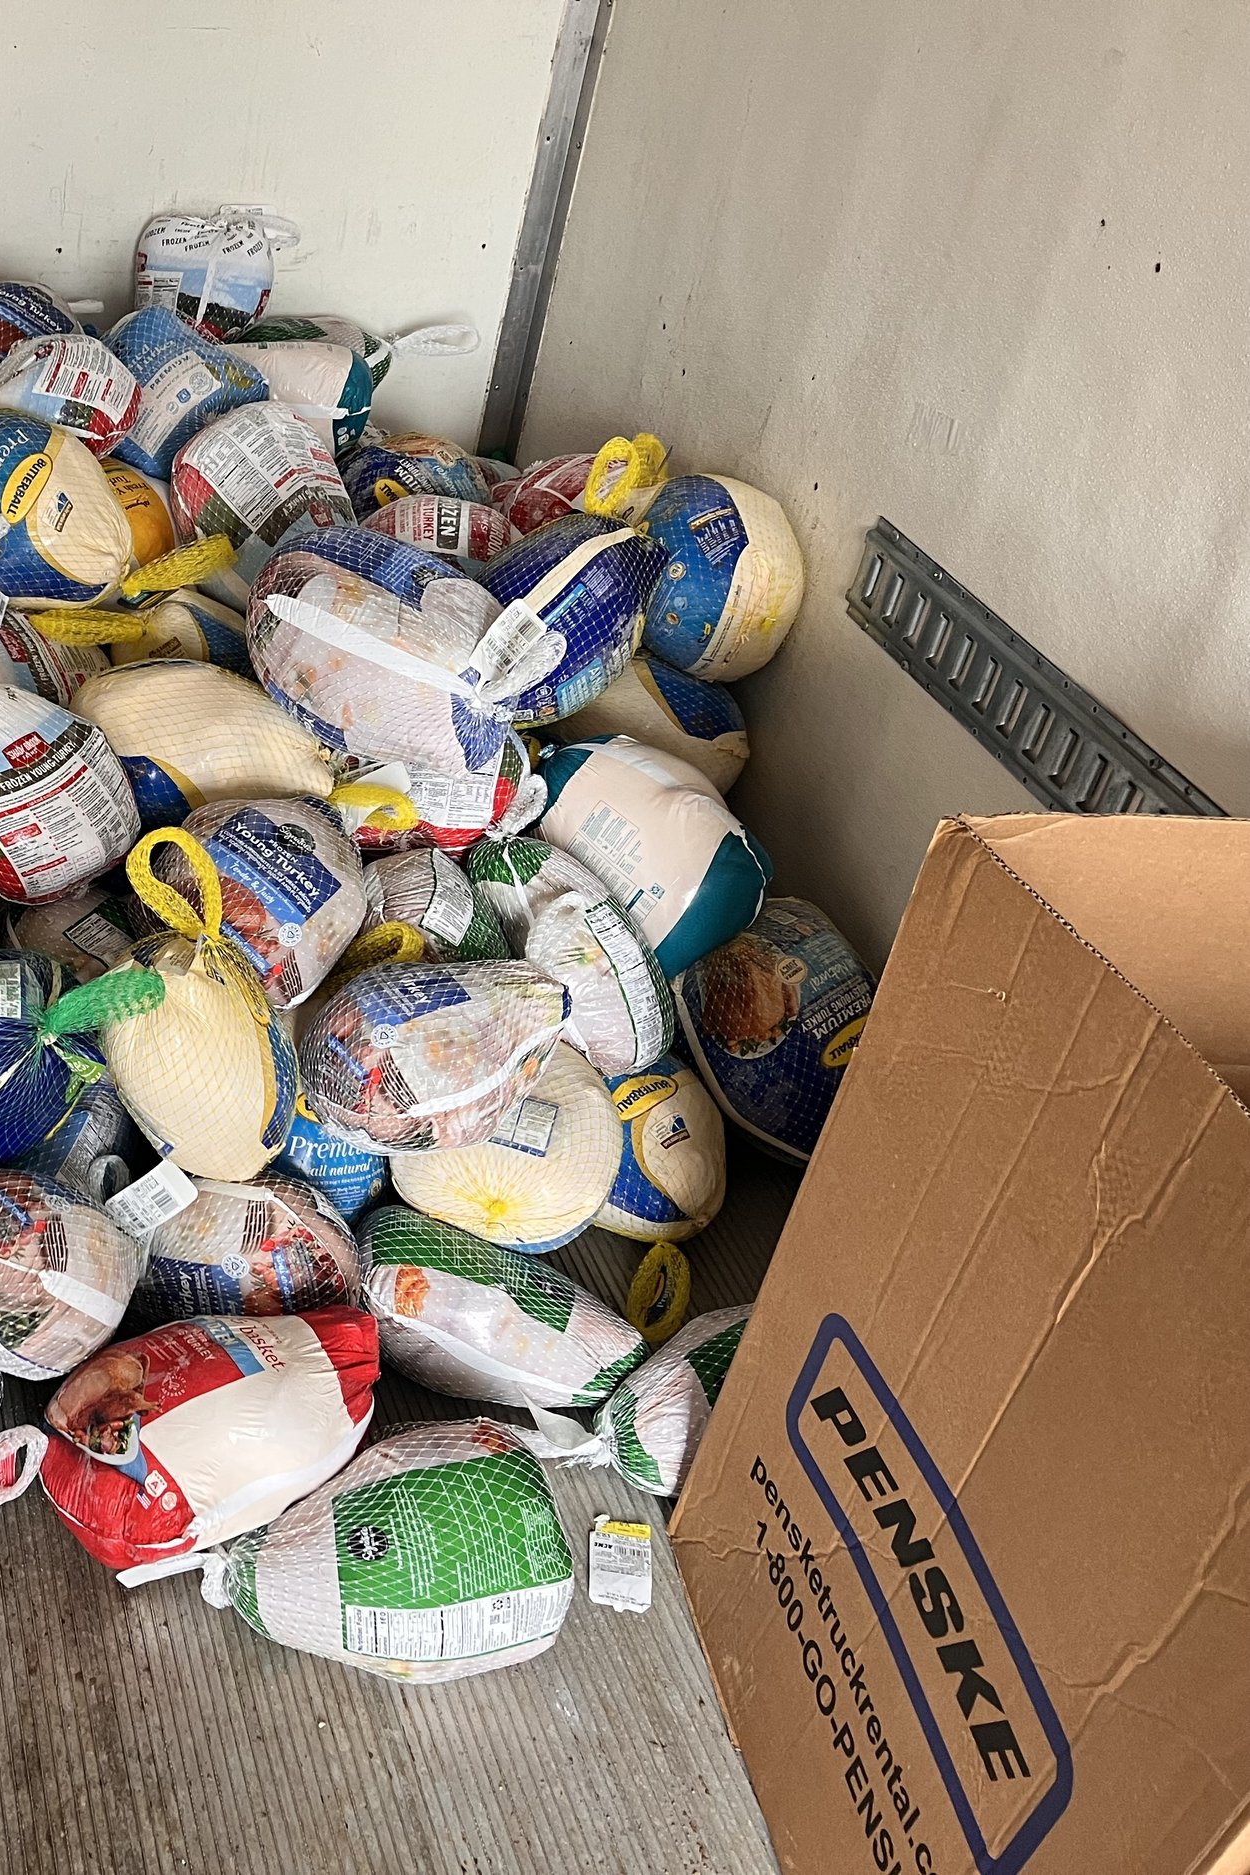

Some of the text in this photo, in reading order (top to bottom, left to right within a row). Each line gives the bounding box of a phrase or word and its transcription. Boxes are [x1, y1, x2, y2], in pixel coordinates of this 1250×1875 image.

[162, 237, 187, 247] FROZEN
[184, 240, 211, 252] FROZEN
[222, 240, 245, 254] FROZEN
[29, 305, 63, 332] Turkey
[6, 457, 49, 519] BUTTERBALL
[423, 506, 434, 541] TURKEY
[0, 743, 76, 791] FROZEN YOUNG TURKEY
[7, 744, 25, 760] SHADY
[235, 822, 321, 899] Young Turkey
[268, 839, 298, 864] FROZEN
[250, 879, 259, 890] &
[801, 1007, 829, 1033] TURKEY
[812, 994, 873, 1040] PREMIUM
[616, 1080, 672, 1113] BUTTERBALL
[310, 1158, 371, 1177] all natural
[184, 1334, 217, 1362] TURKEY
[239, 1325, 287, 1373] basket
[810, 1386, 1031, 1782] PENSKE
[749, 1455, 938, 1875] pensketruckrental.c
[755, 1520, 902, 1875] 1-800-GO-PENS
